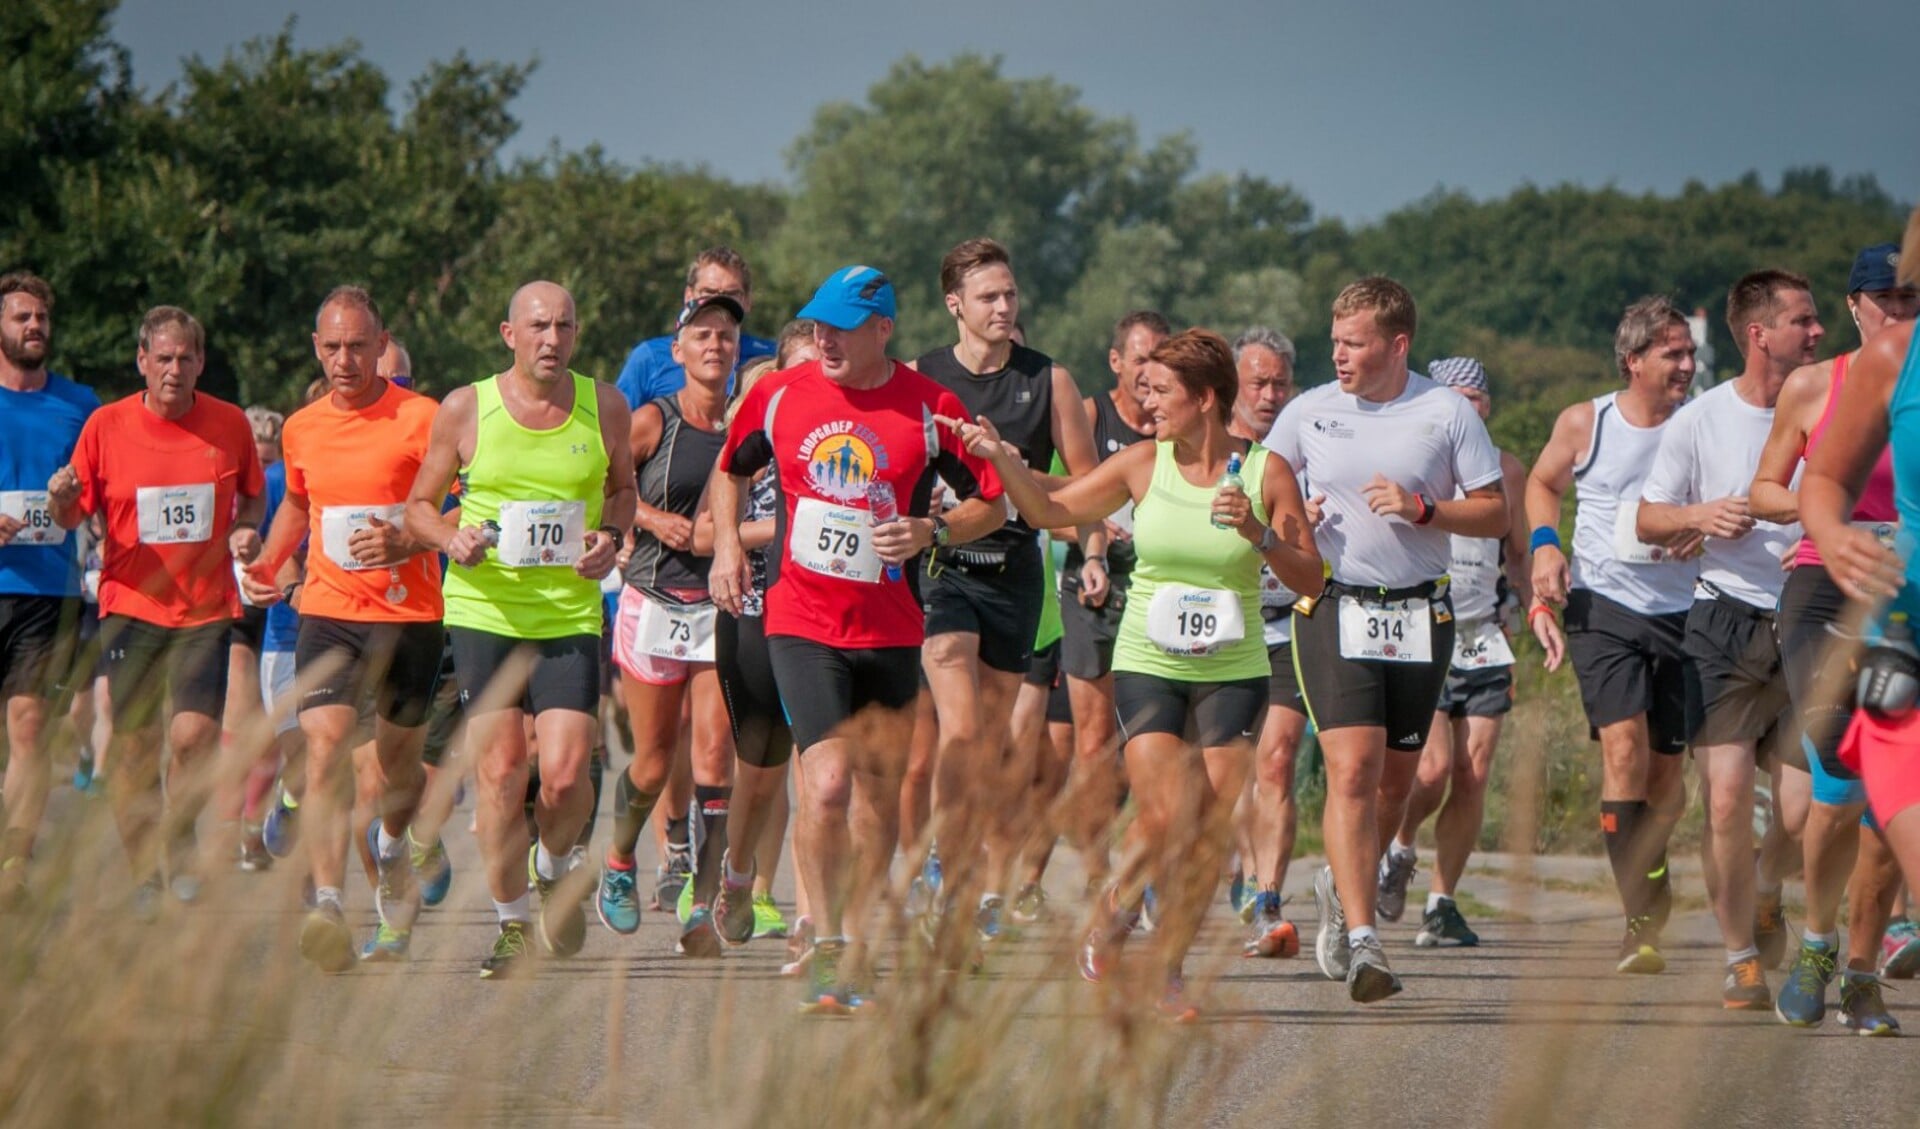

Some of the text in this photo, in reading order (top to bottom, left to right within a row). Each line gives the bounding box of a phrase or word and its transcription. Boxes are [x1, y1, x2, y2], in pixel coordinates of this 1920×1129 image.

[797, 420, 889, 470] LOOPGROEP ZEELAND
[23, 508, 52, 528] 465
[162, 504, 195, 525] 135
[527, 523, 563, 546] 170
[818, 527, 859, 557] 579
[519, 557, 540, 565] ABM
[807, 561, 862, 578] ABM ICT
[670, 619, 690, 642] 73
[1178, 611, 1217, 637] 199
[1367, 617, 1404, 642] 314
[1361, 649, 1383, 657] ABM
